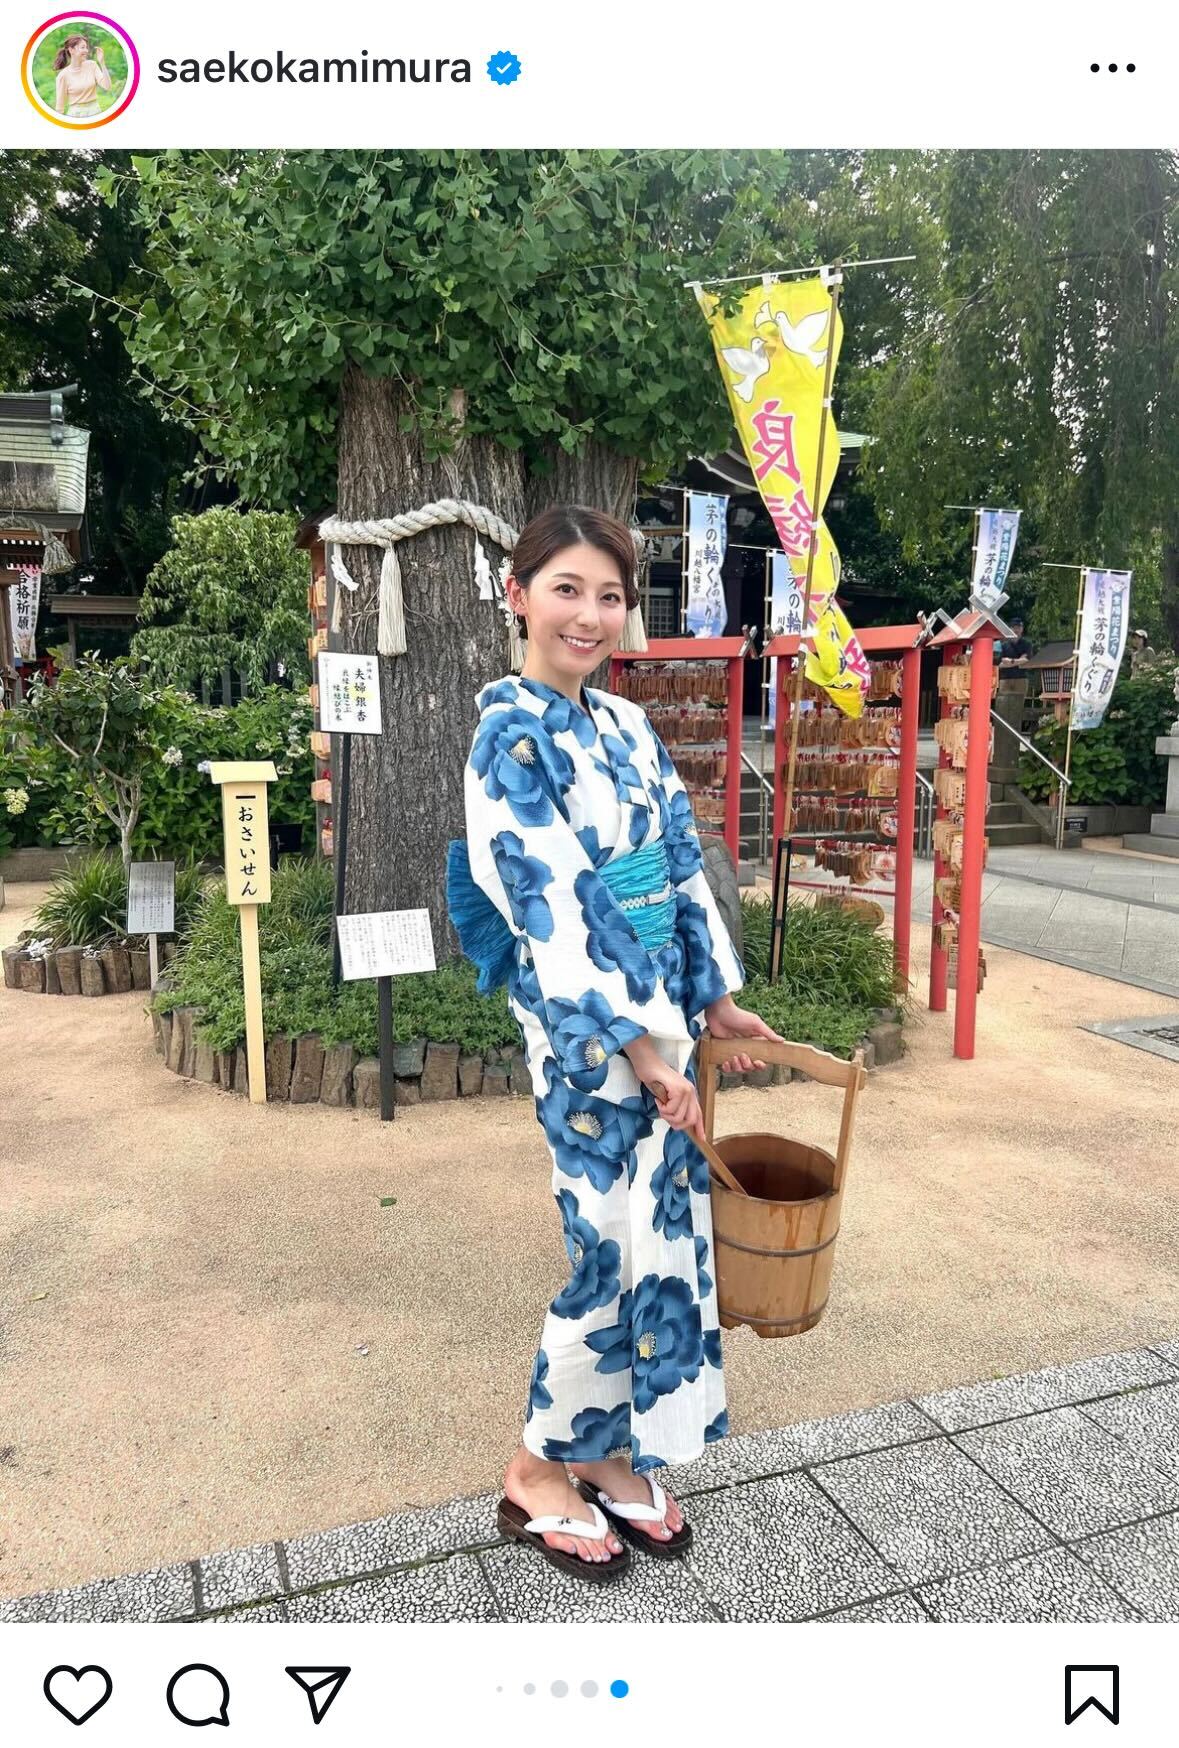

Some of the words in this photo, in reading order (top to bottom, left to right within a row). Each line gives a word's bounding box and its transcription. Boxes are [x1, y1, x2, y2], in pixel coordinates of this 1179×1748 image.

[16, 568, 31, 630] 合格祈願
[1083, 617, 1109, 693] 茅の輪くぐり
[354, 668, 367, 722] 夫婦銀杏
[239, 806, 257, 896] おさいせん
